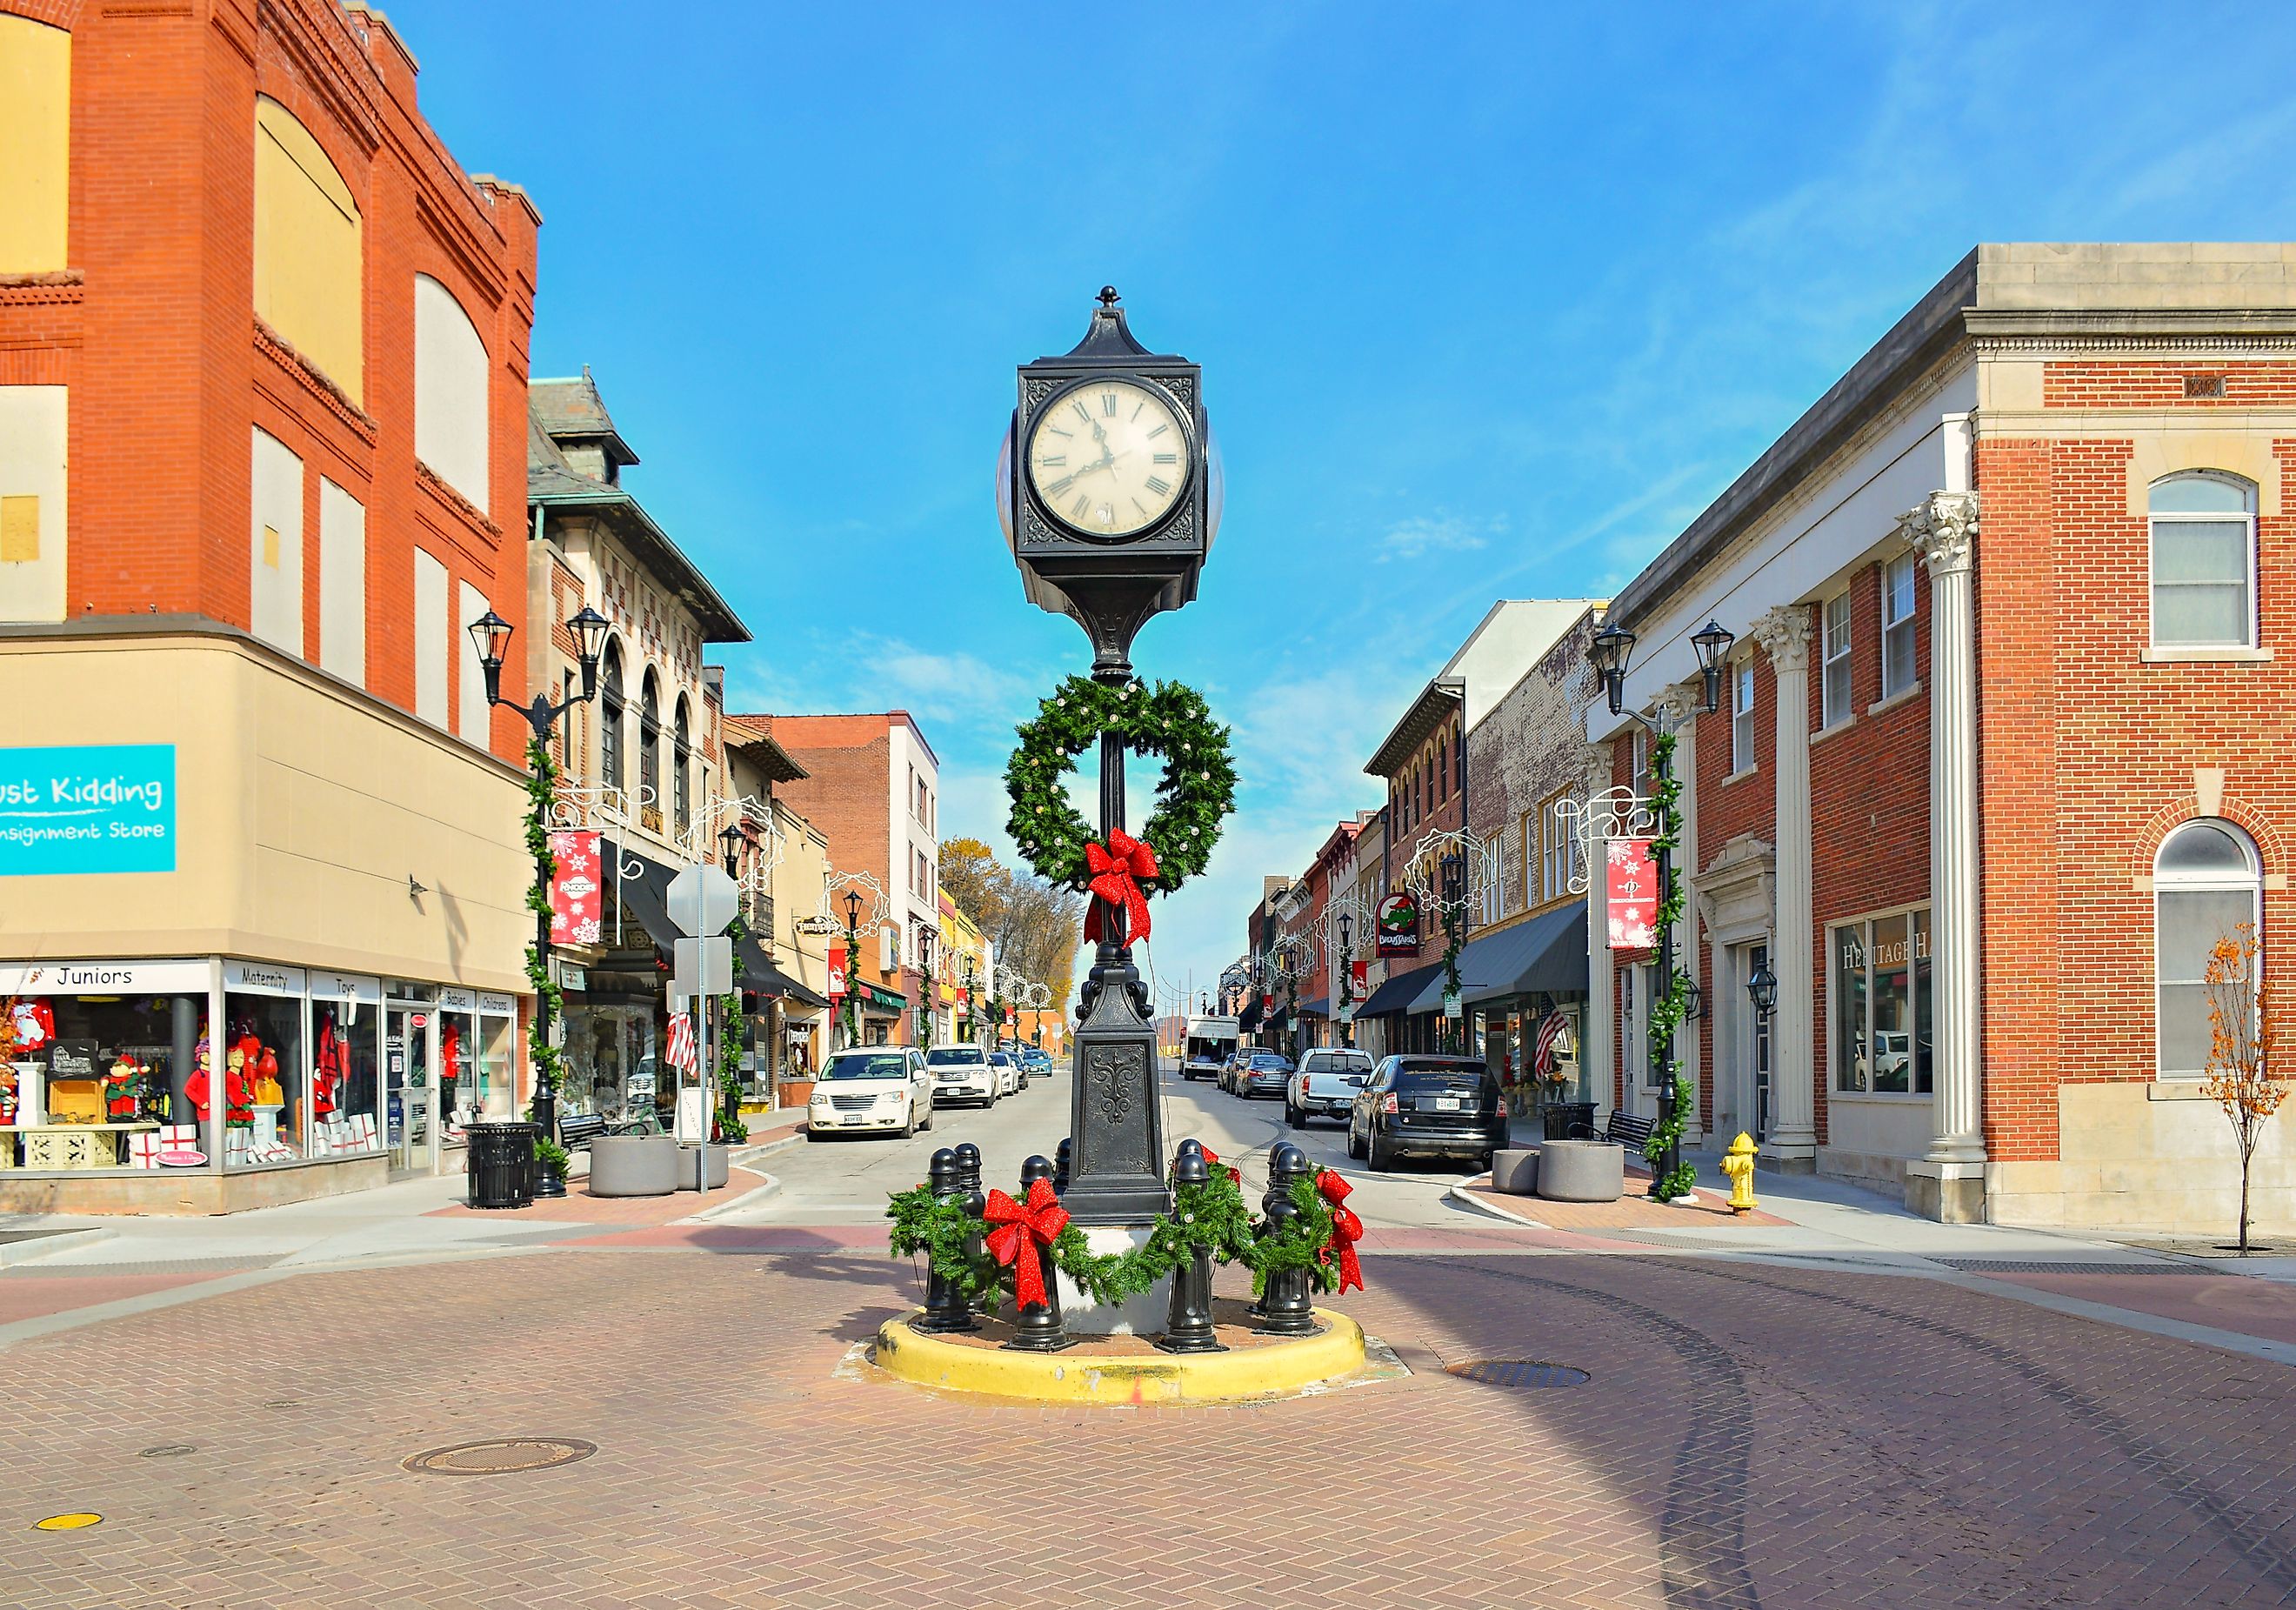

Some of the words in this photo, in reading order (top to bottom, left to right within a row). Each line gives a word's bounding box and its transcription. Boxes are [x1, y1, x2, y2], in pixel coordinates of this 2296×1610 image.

[1101, 394, 1116, 418] XII
[1153, 454, 1177, 464] III
[50, 775, 163, 811] Kidding
[109, 822, 165, 838] Store
[1914, 932, 1932, 959] H
[57, 967, 132, 985] Juniors
[242, 967, 288, 993] Maternity
